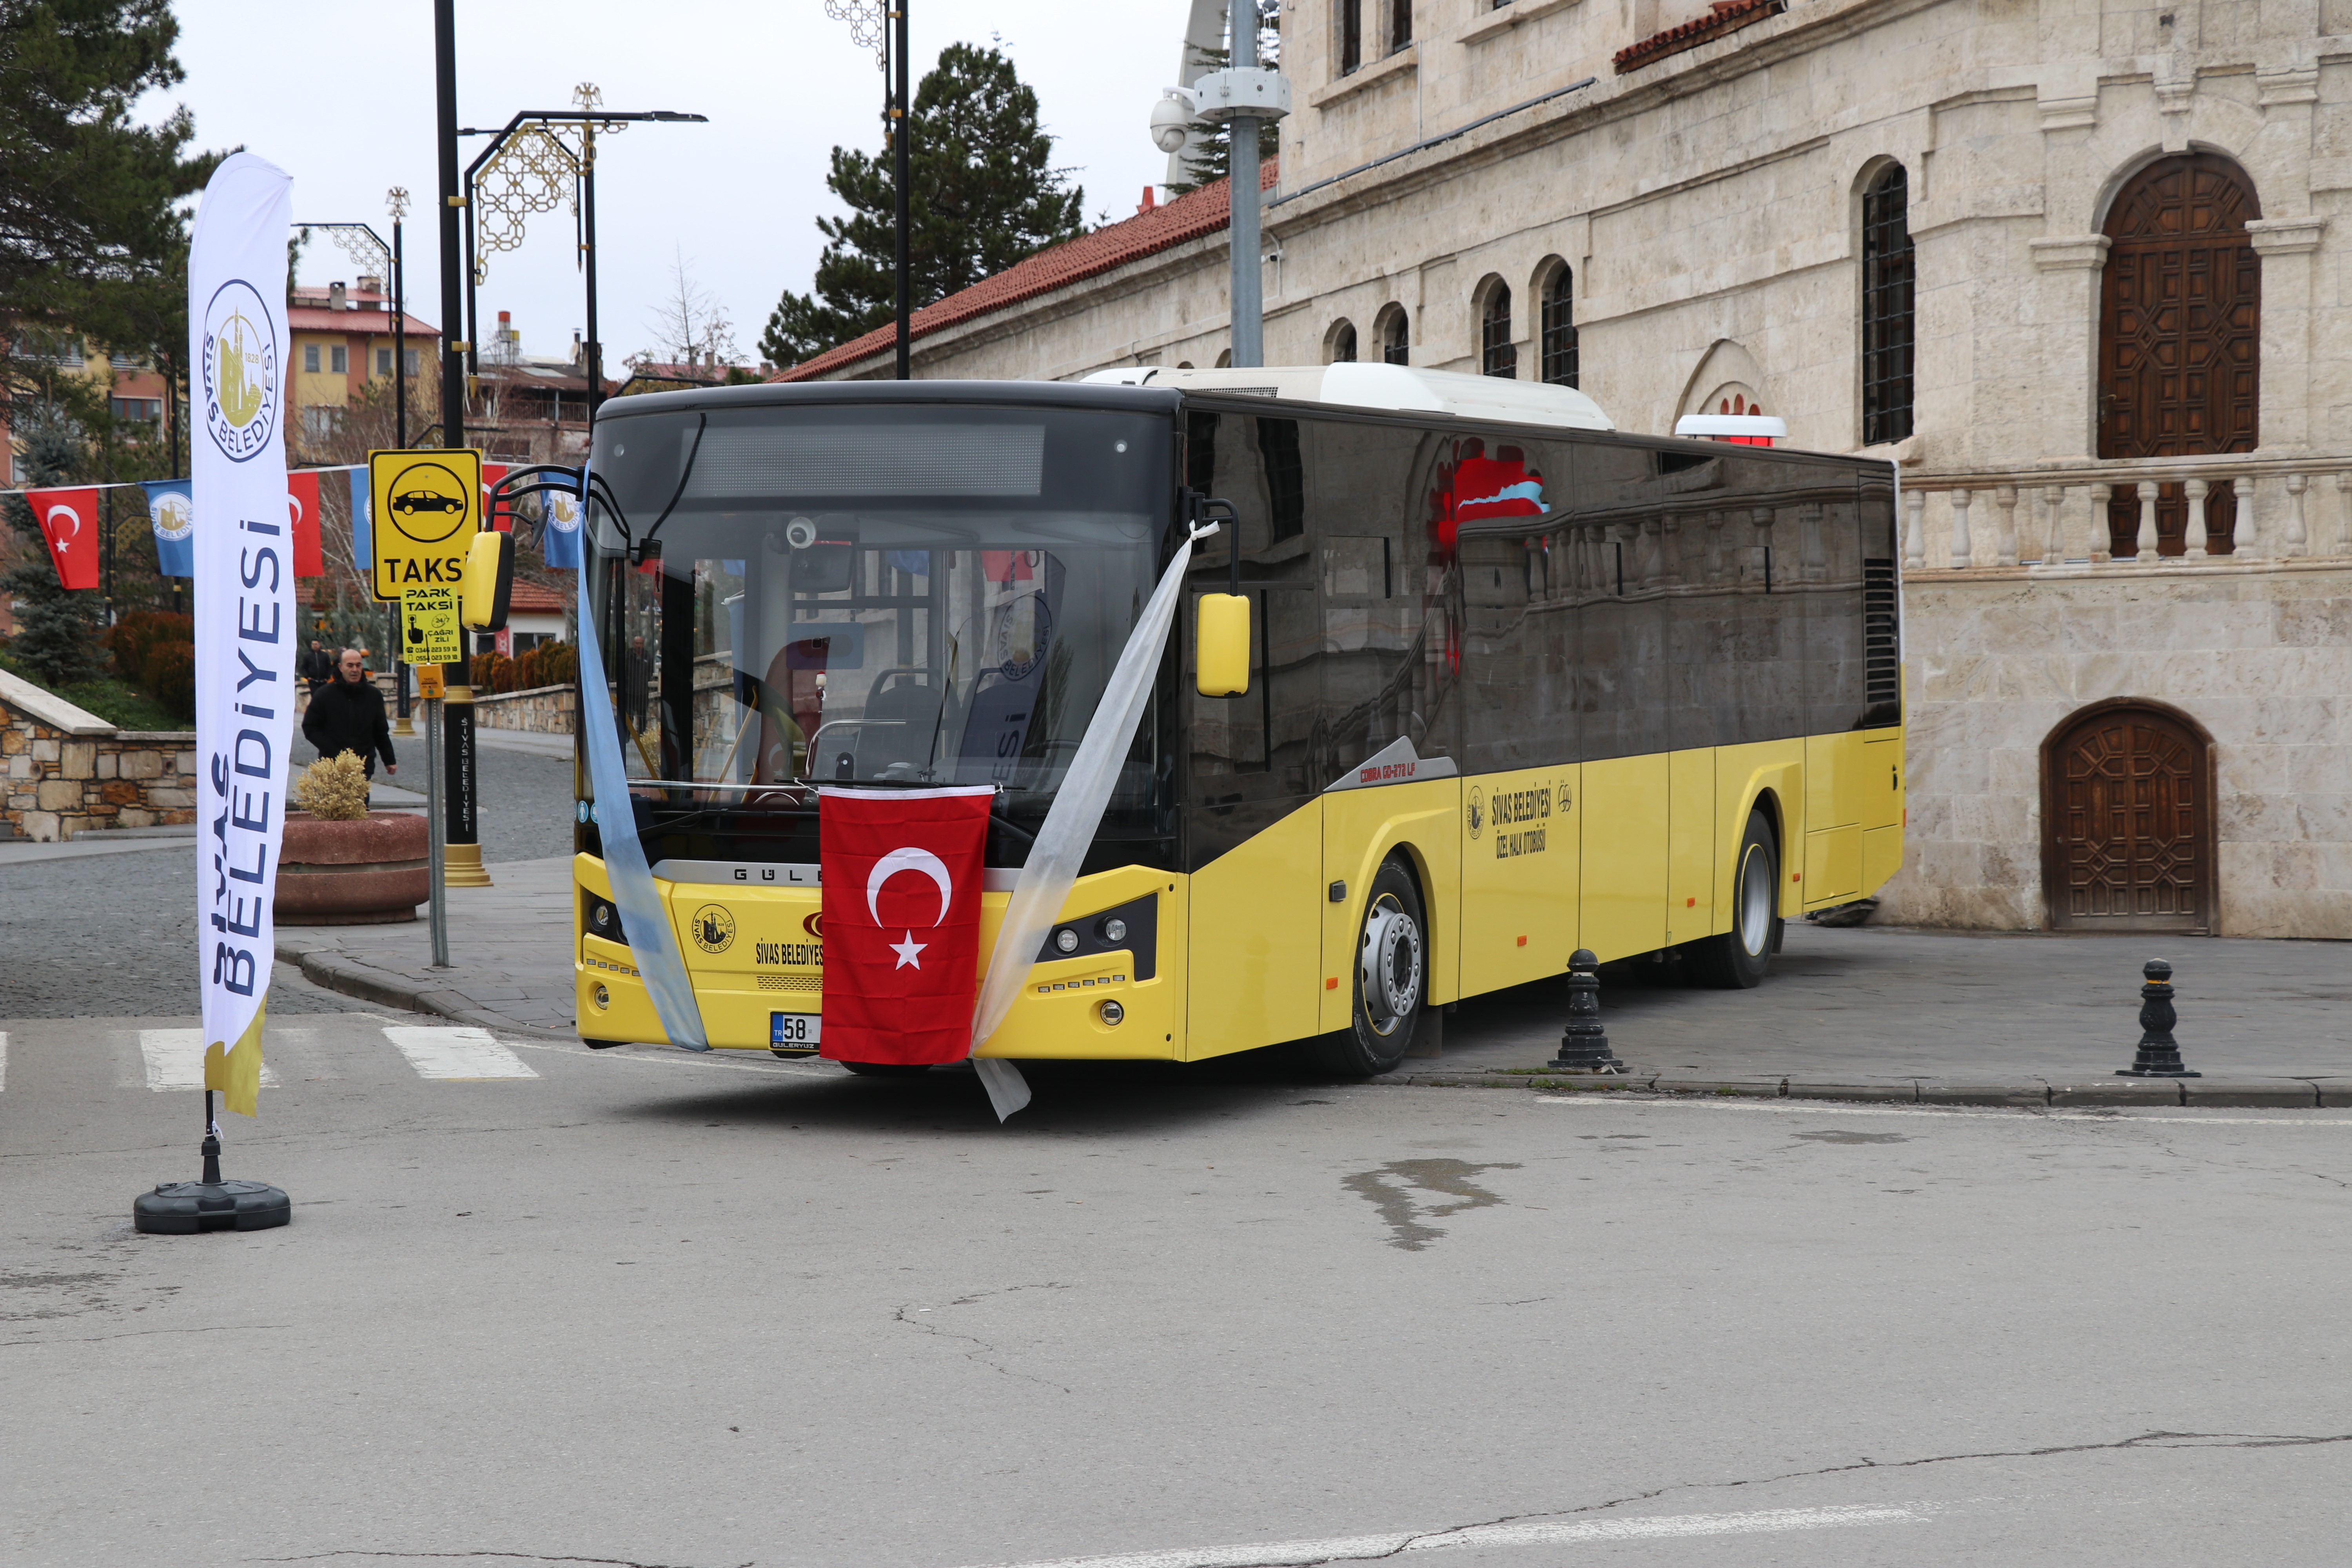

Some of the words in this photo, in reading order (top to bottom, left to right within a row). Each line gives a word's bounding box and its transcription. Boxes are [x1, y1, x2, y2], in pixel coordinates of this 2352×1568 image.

[245, 352, 259, 364] 1828
[218, 343, 274, 453] BELEDİYESİ
[406, 588, 452, 598] PARK
[406, 598, 453, 611] TAKSİ
[428, 629, 454, 637] ÇAĞRI
[225, 520, 281, 997] BELEDİYESİ
[1360, 767, 1382, 783] COBRA
[1408, 762, 1416, 776] LF
[1492, 786, 1512, 826] SİVAS
[1514, 779, 1551, 822] BELEDİYESİ
[1497, 829, 1509, 859] ÖZEL
[1510, 832, 1523, 857] HALK
[1524, 822, 1546, 855] OTOBÜSÜ
[756, 937, 779, 965] SİVAS
[784, 1018, 806, 1040] 58
